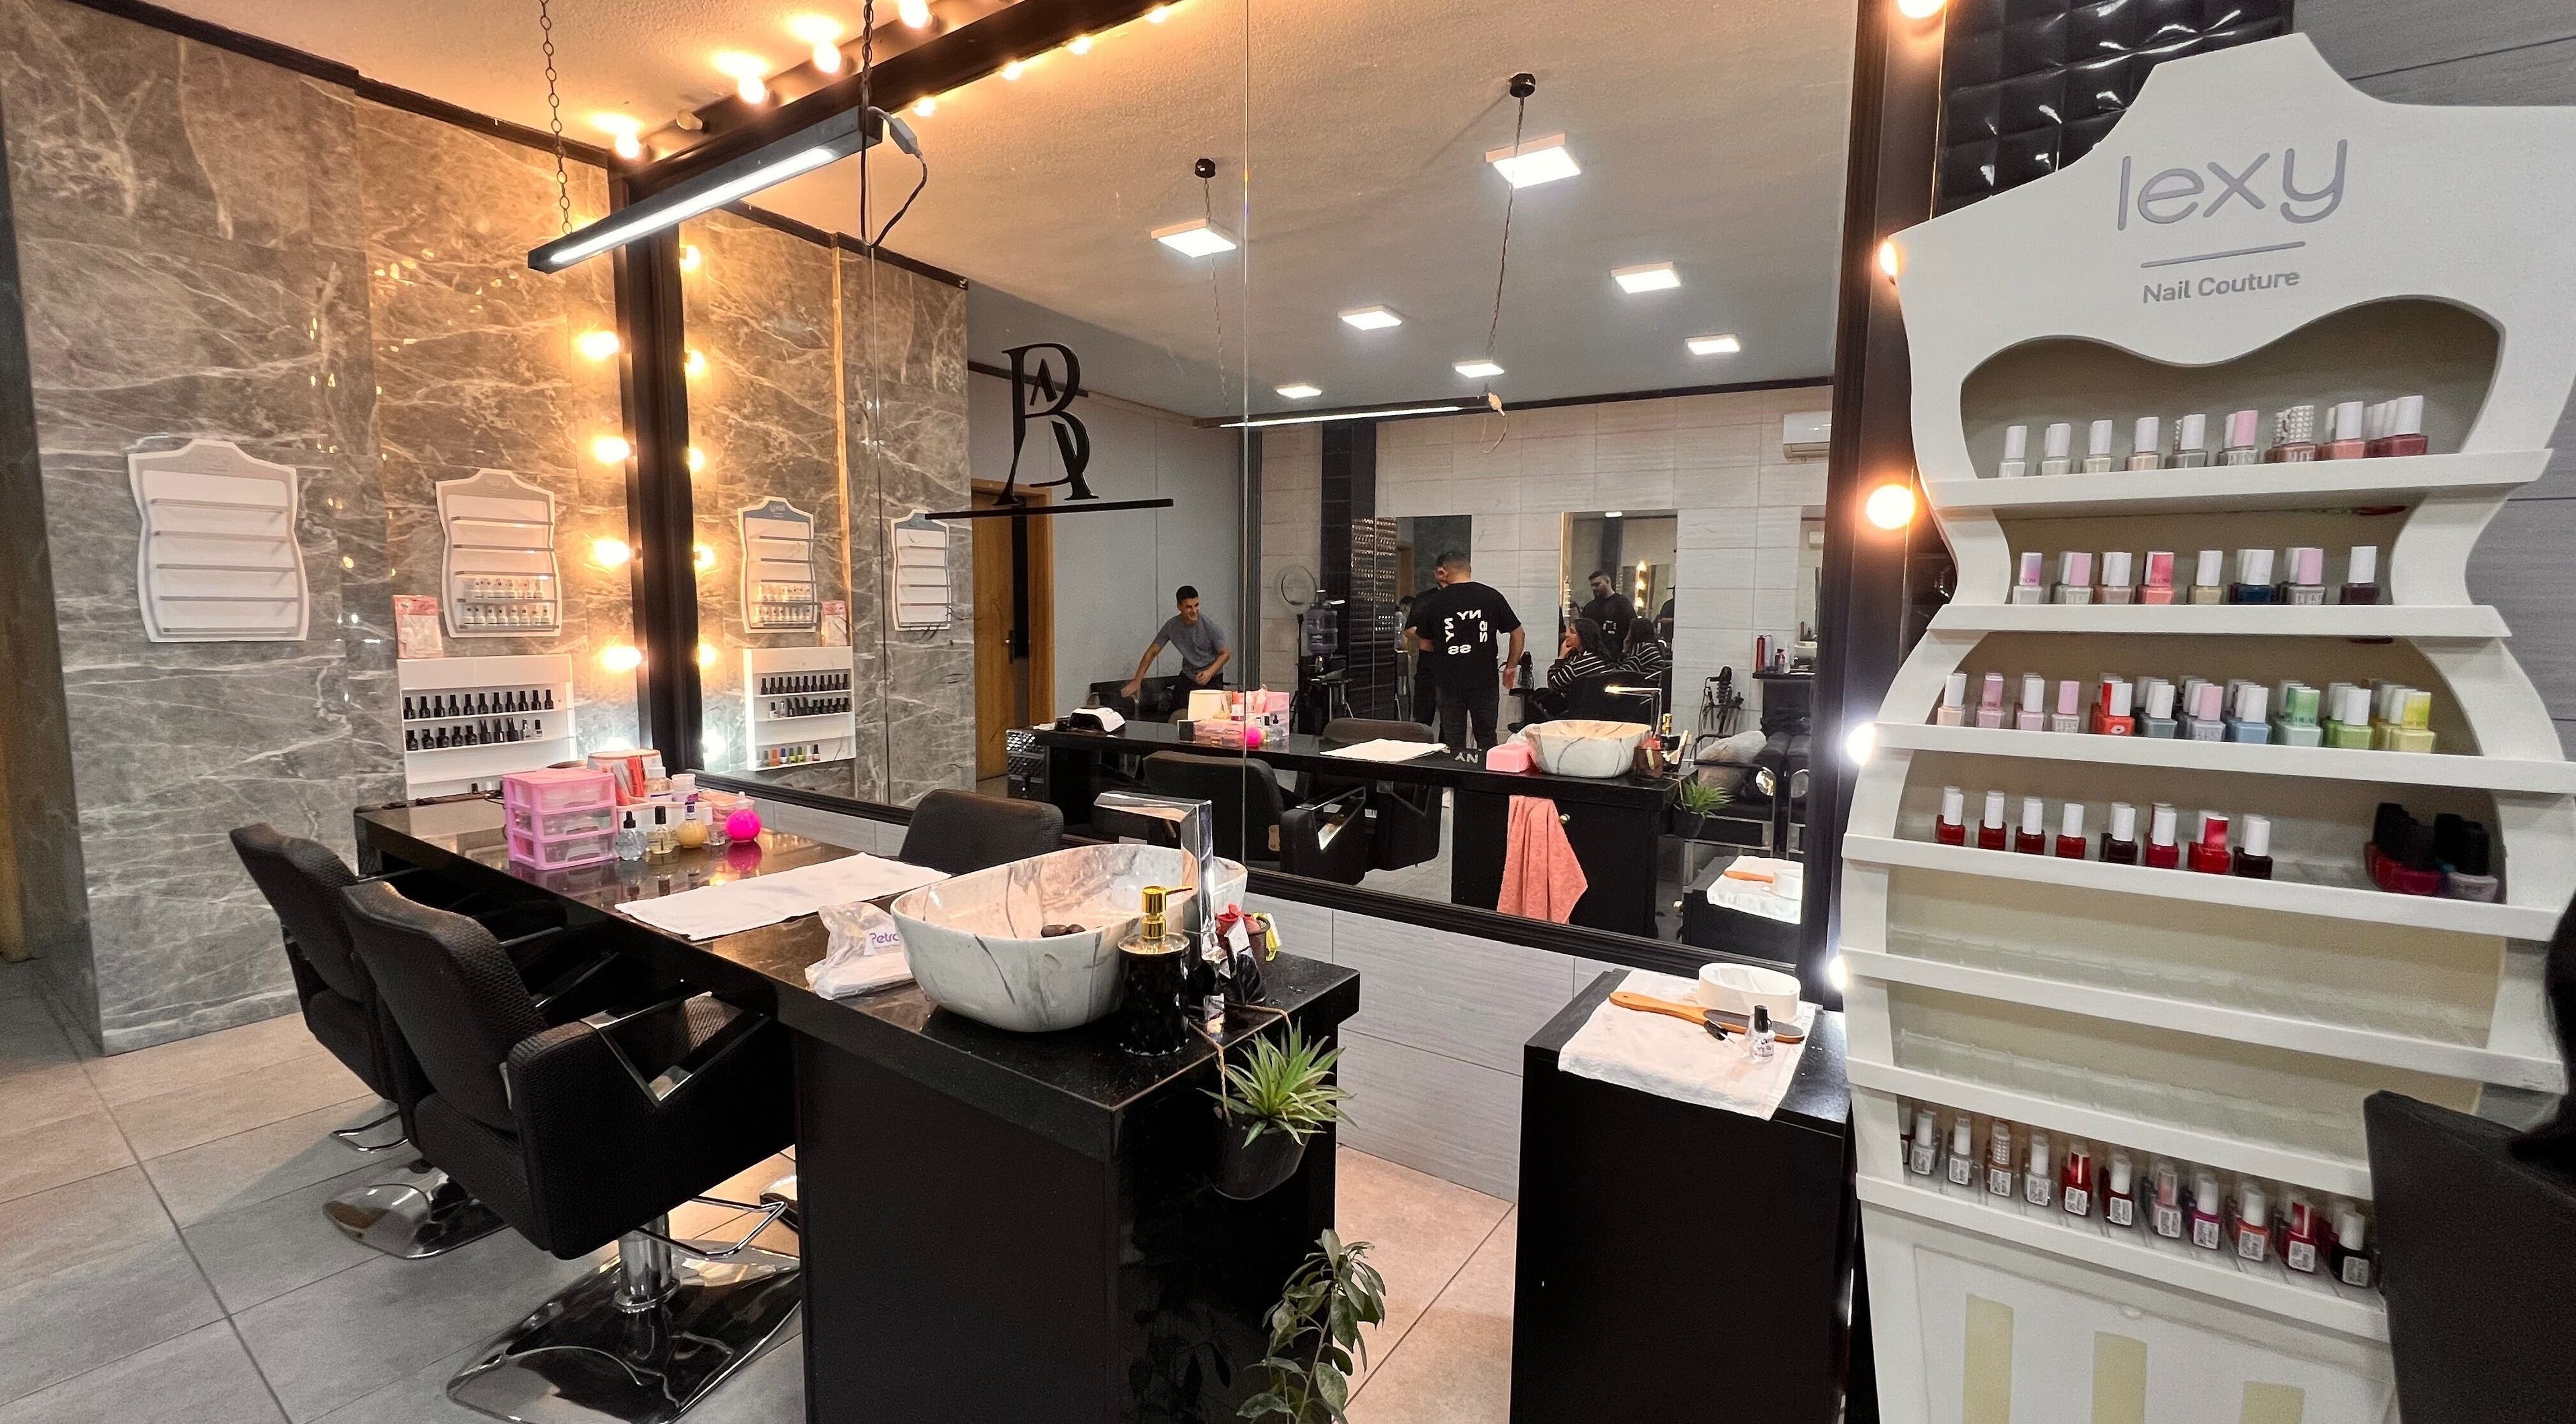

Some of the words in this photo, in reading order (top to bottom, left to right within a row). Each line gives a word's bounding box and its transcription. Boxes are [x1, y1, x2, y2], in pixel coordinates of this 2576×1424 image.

[2117, 138, 2348, 231] lexy
[2142, 280, 2190, 304] Nail
[2198, 270, 2300, 295] Couture
